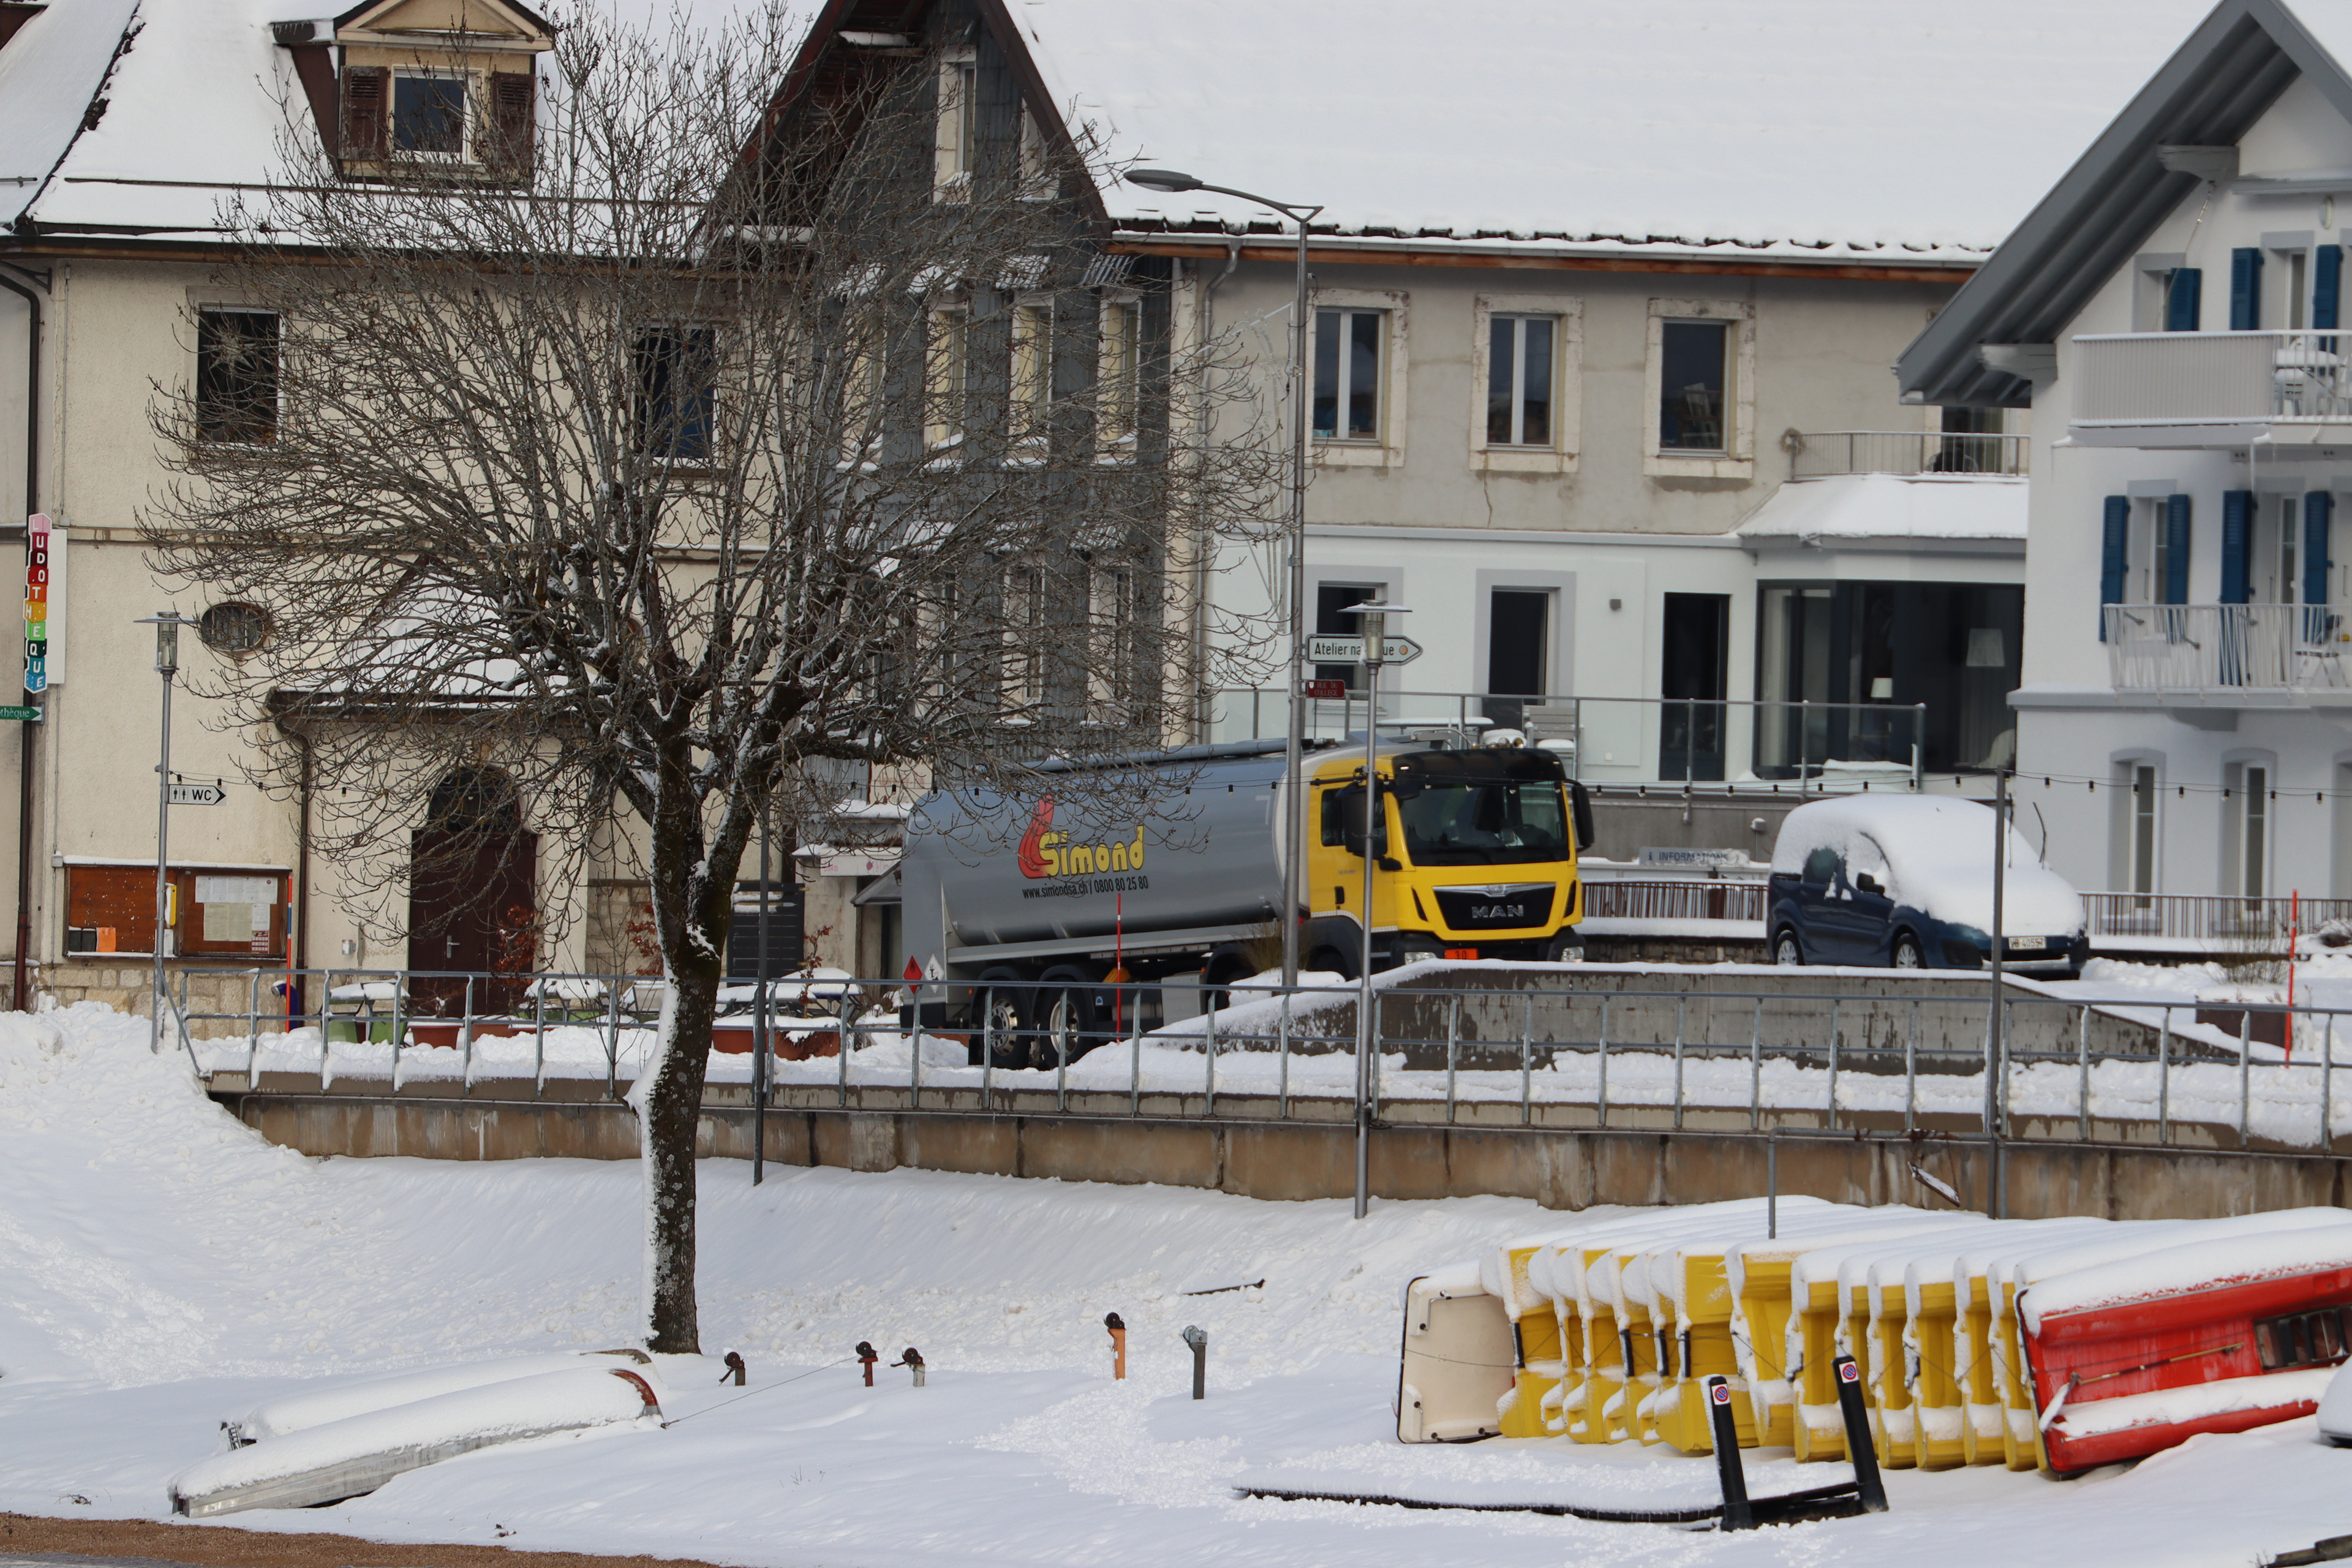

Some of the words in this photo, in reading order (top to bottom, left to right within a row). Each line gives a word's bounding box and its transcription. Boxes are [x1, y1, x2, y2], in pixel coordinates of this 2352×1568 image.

[26, 518, 46, 688] LUDOTHÈQUE
[1314, 643, 1348, 655] Atelier
[1351, 645, 1394, 656] naue
[192, 789, 212, 801] WC
[1038, 824, 1144, 876] Simond
[1022, 880, 1088, 899] www.simondsa.ch
[1094, 878, 1114, 893] 0800
[1115, 877, 1126, 892] 80
[1126, 876, 1137, 891] 25
[1138, 875, 1148, 890] 80
[1471, 904, 1525, 918] MAN
[1455, 950, 1467, 960] 30
